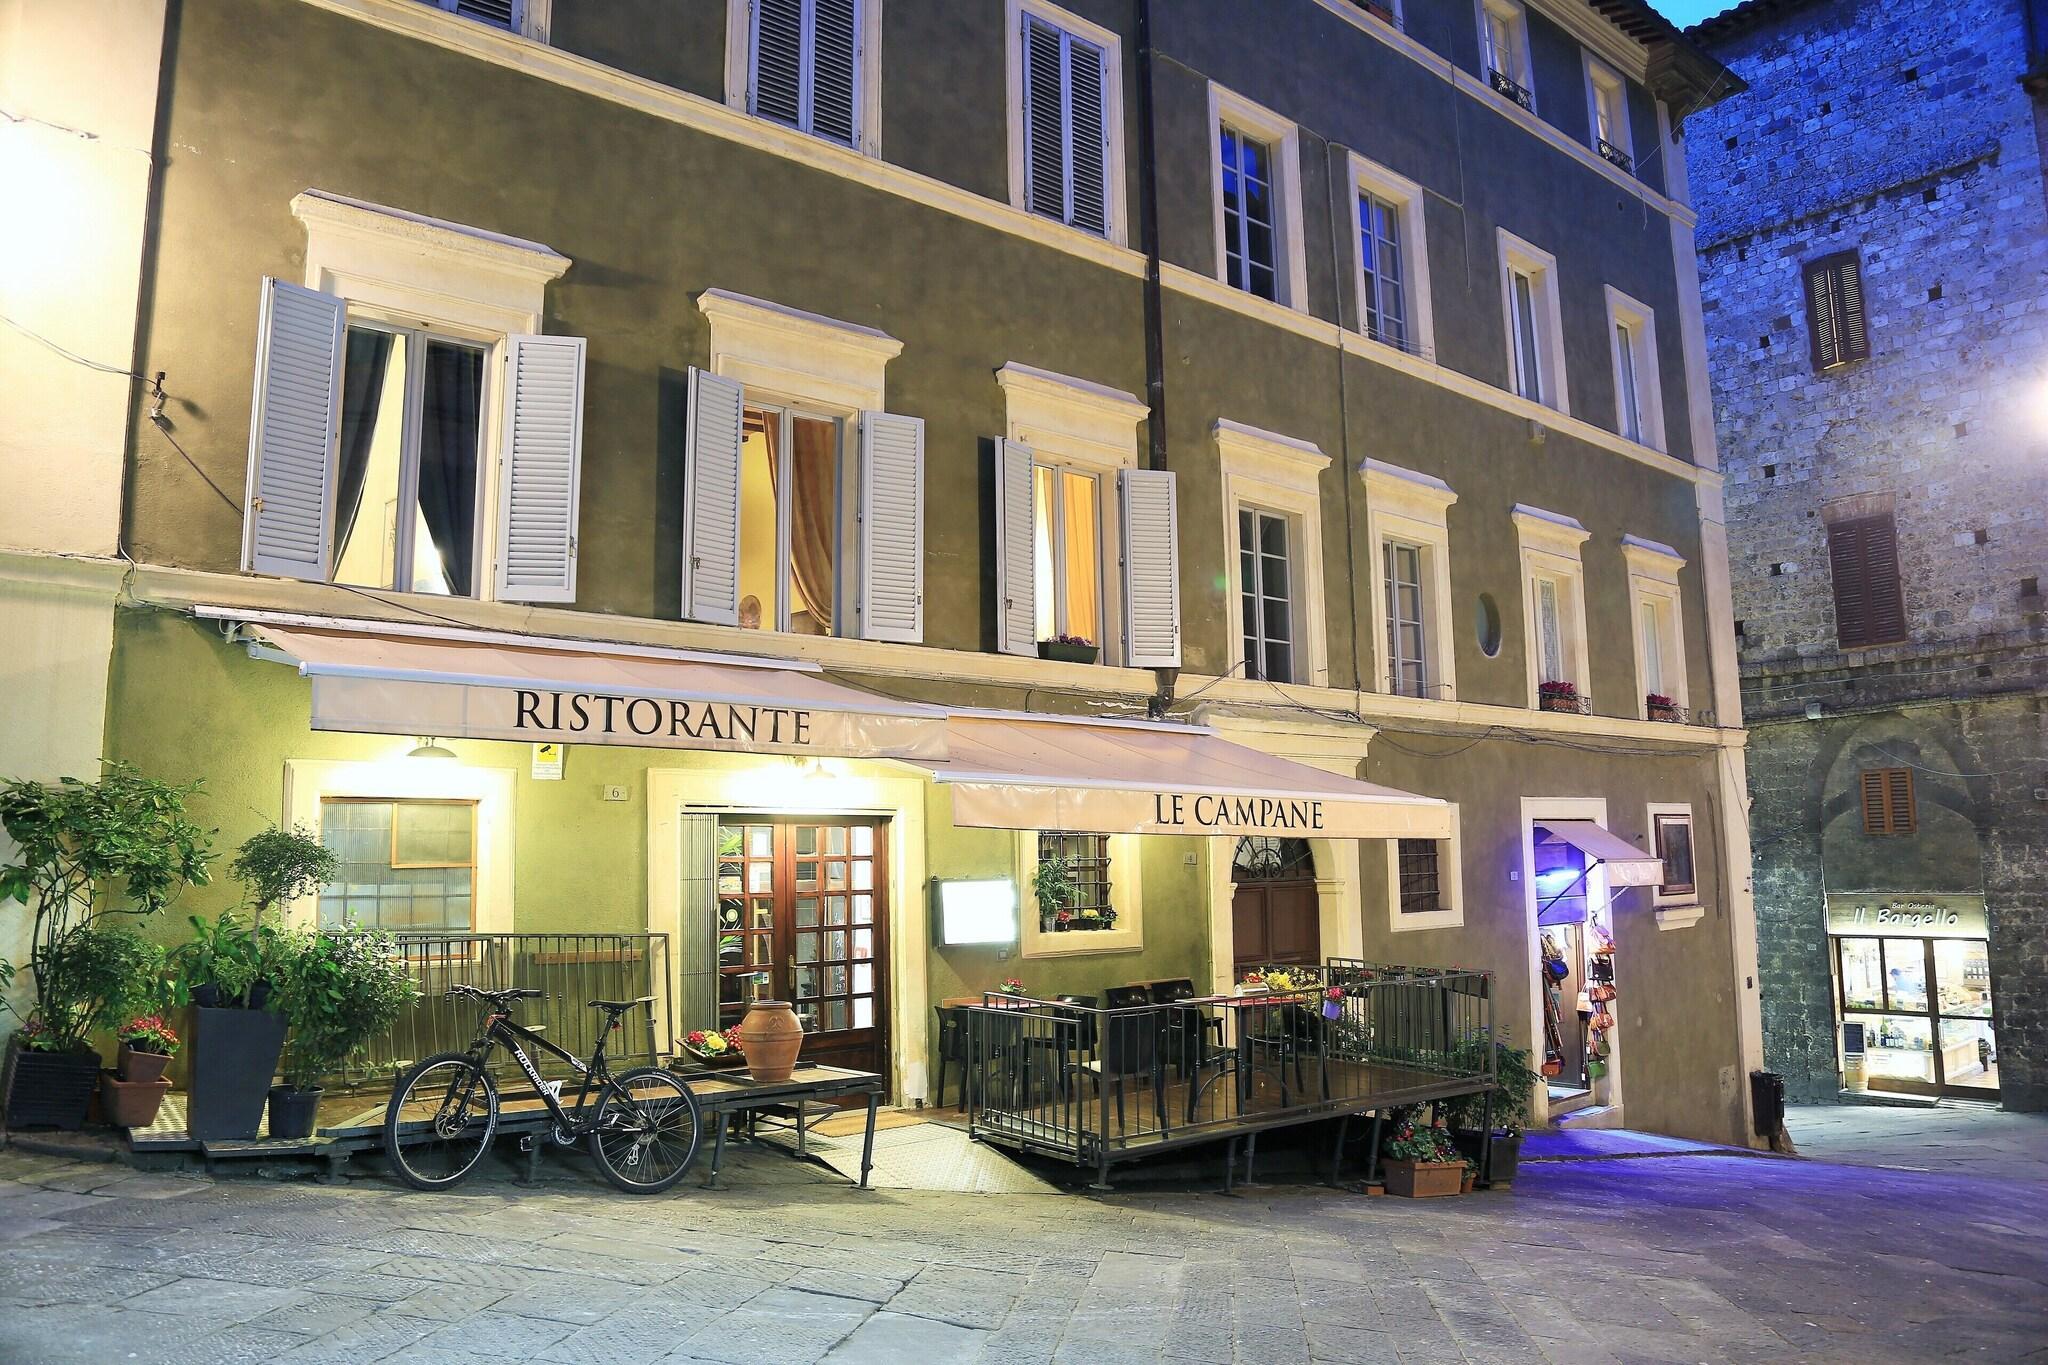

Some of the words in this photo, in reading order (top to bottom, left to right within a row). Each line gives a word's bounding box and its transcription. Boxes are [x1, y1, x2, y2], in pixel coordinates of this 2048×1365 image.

[513, 690, 811, 745] RISTORANTE
[612, 787, 620, 798] 6
[1153, 793, 1185, 825] LE
[1194, 795, 1324, 829] CAMPANE
[1876, 908, 1959, 928] Bargello
[1907, 902, 1936, 910] Osteria
[514, 1048, 550, 1096] ROCKRIDER
